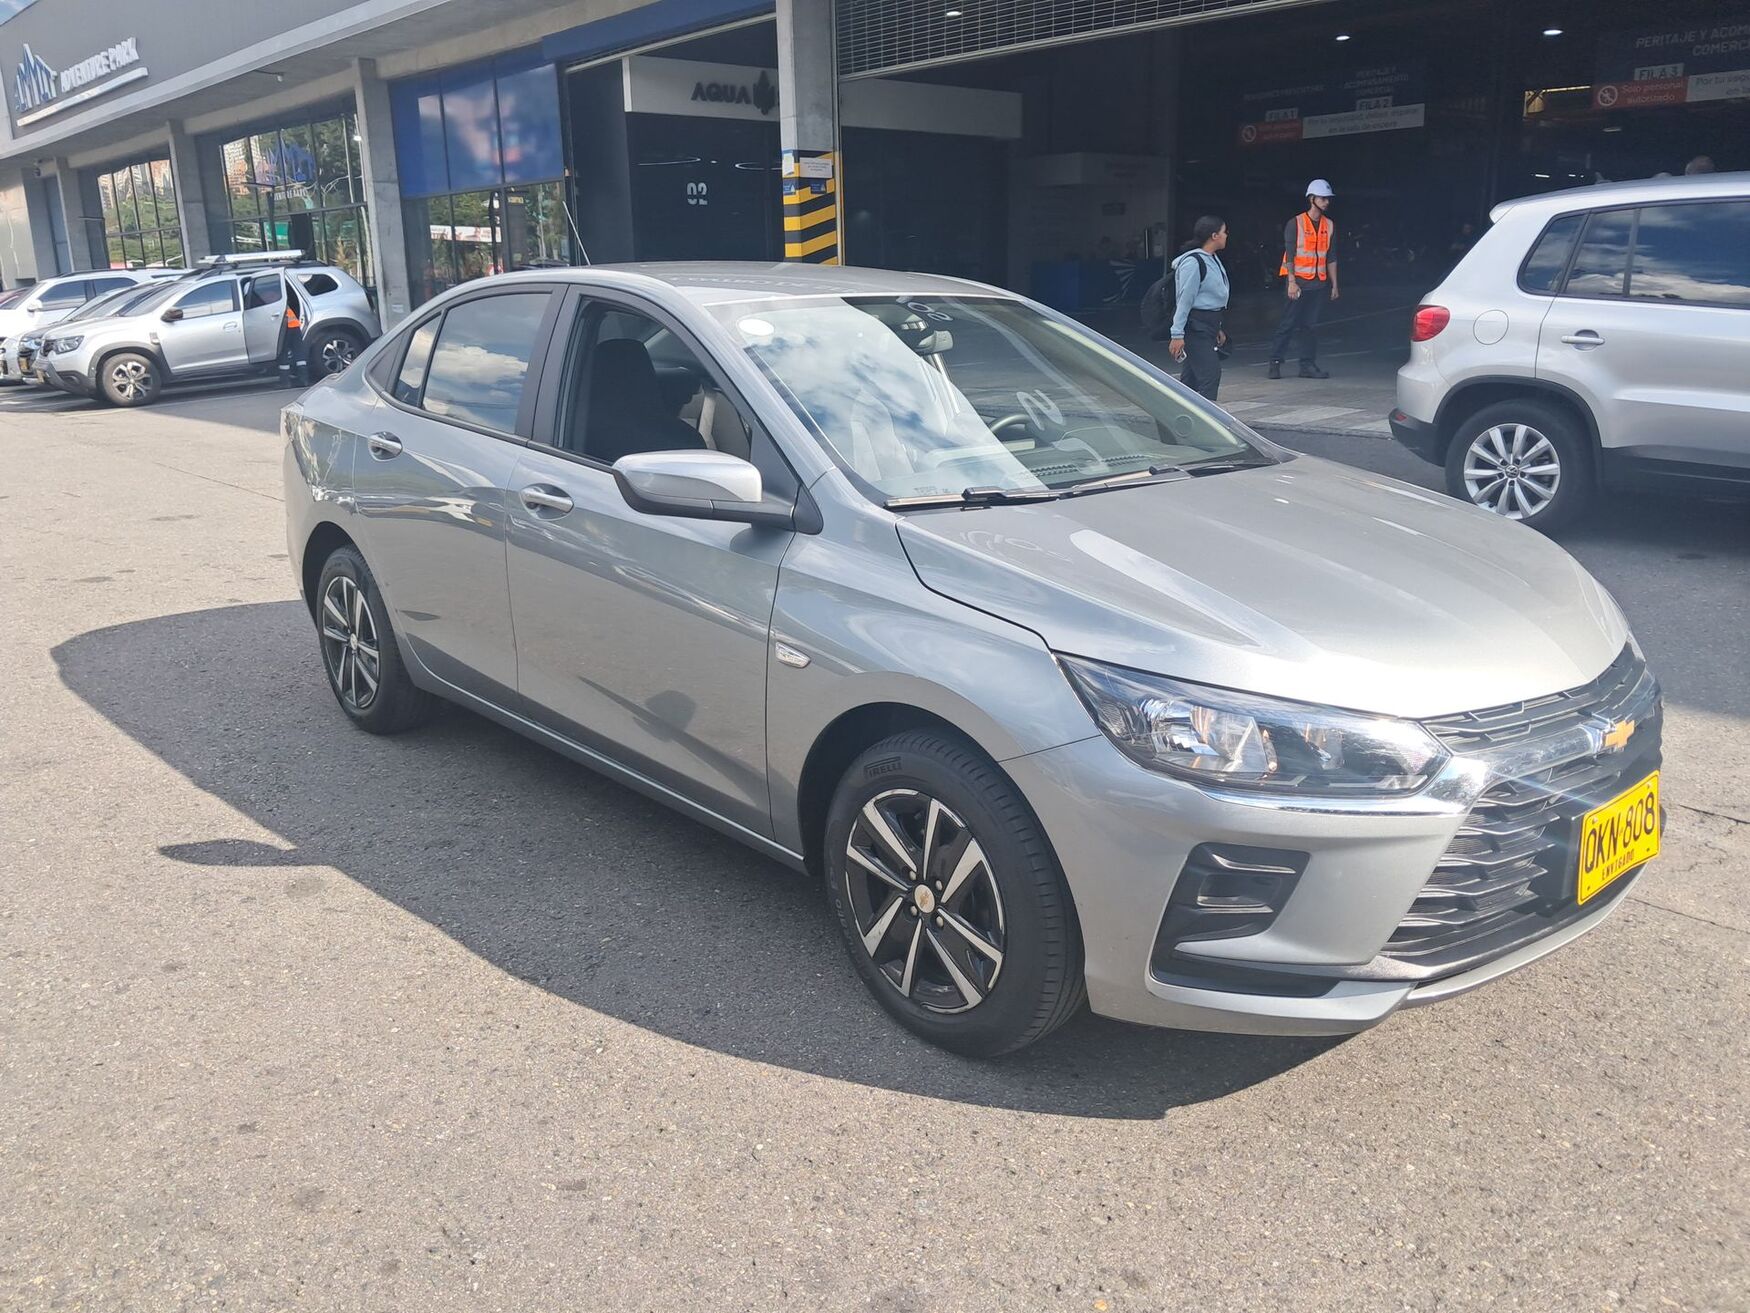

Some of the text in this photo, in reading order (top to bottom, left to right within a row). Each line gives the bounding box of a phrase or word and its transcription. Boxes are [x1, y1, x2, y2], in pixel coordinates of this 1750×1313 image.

[108, 36, 140, 71] PARK
[691, 81, 751, 105] AQUA
[686, 182, 708, 205] 02
[865, 757, 902, 778] PIRELLI
[1601, 848, 1635, 881] ENVIGADO
